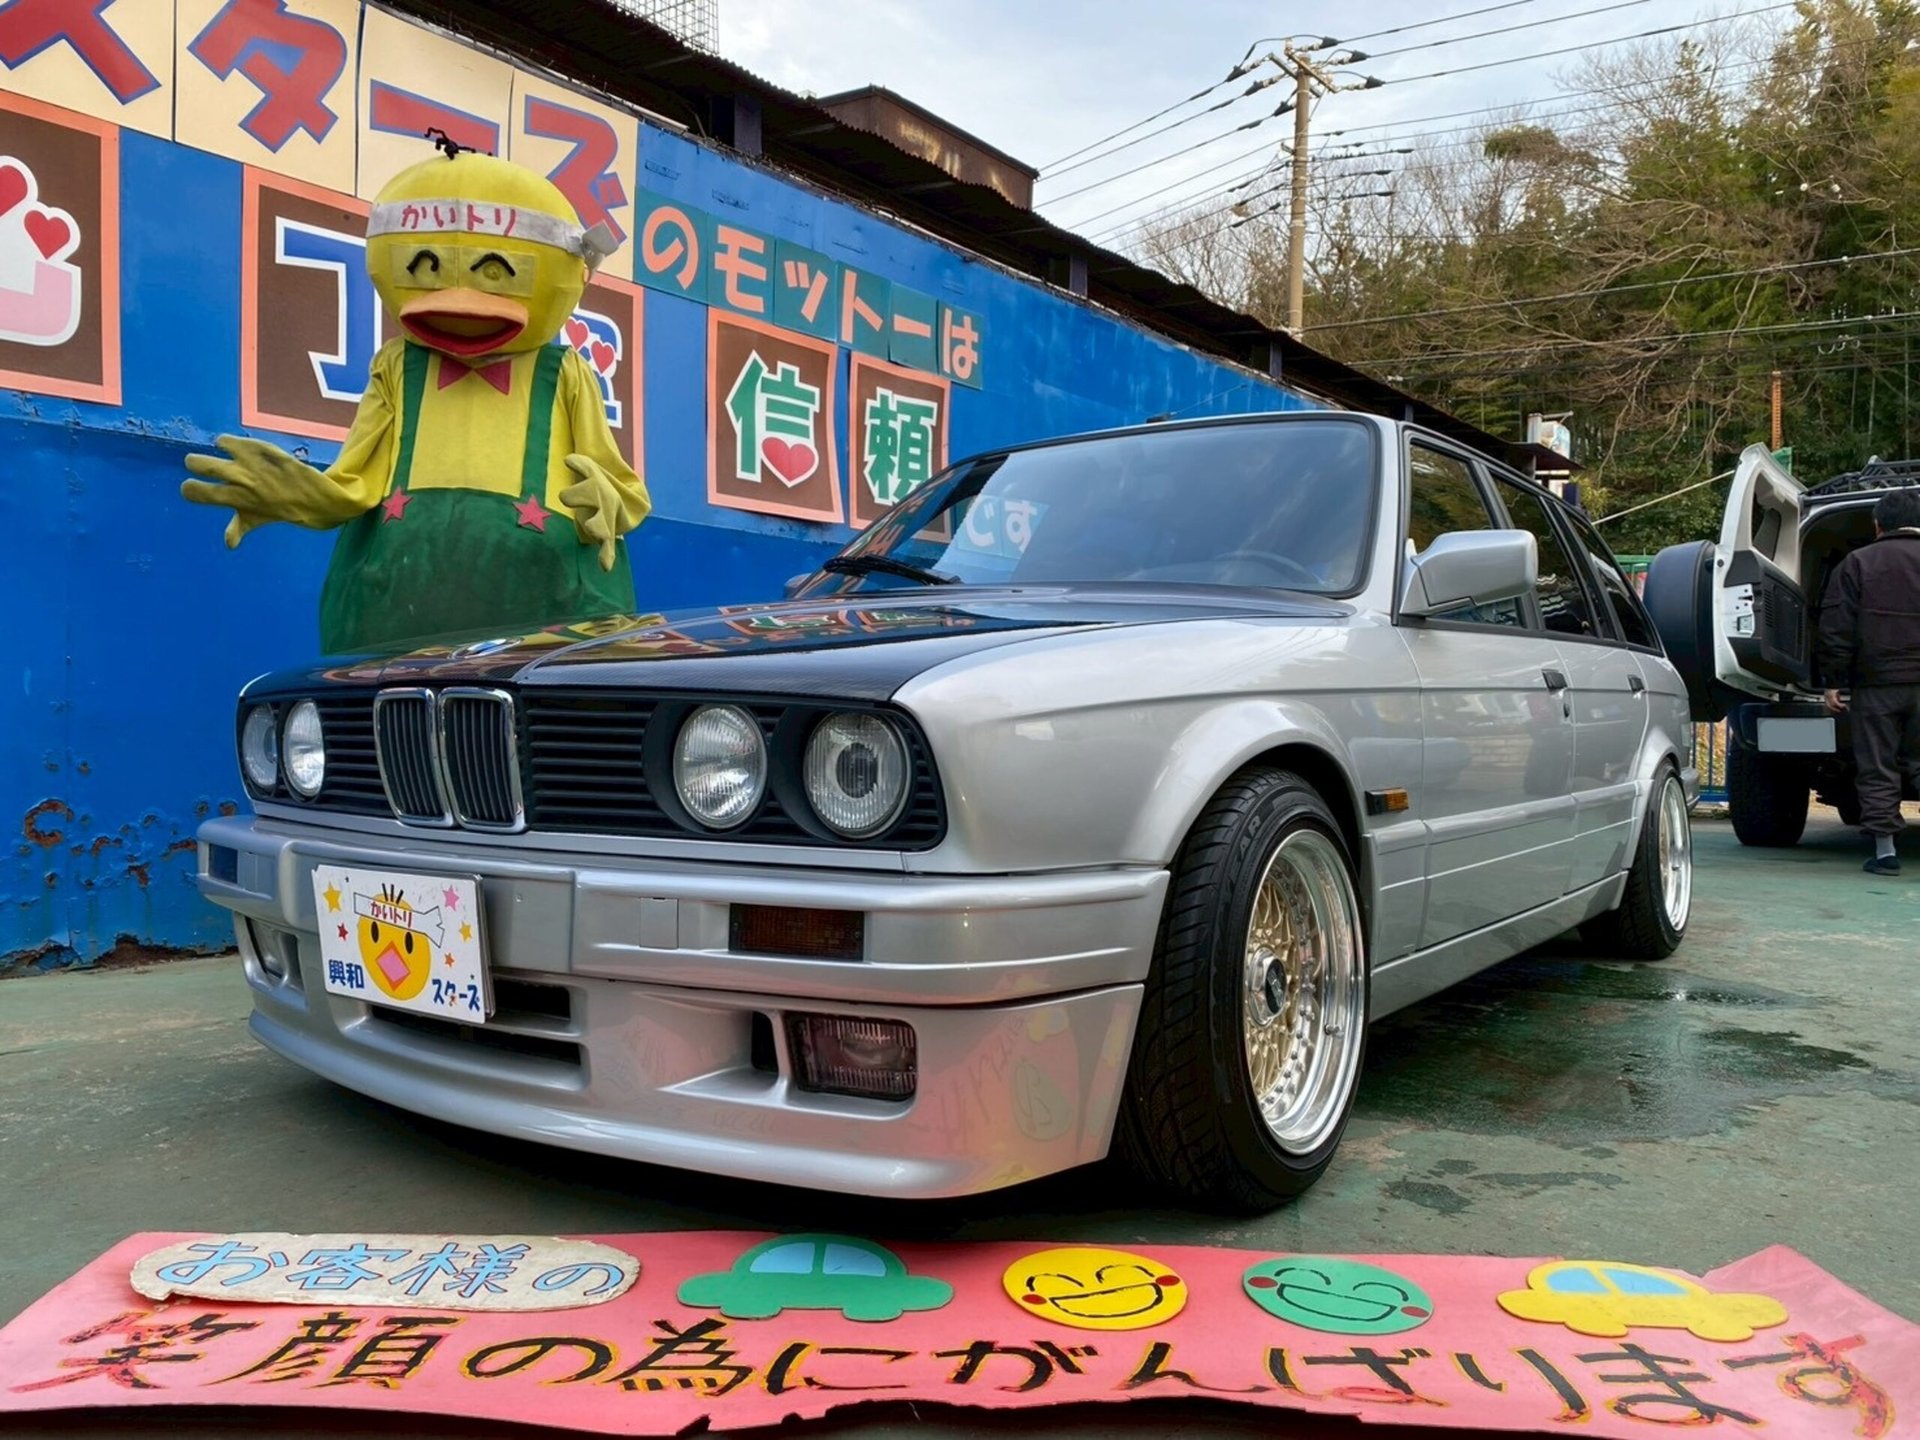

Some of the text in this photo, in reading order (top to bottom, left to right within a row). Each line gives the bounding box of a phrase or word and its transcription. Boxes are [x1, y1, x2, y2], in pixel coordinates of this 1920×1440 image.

[401, 203, 516, 237] かいトリ
[641, 205, 979, 381] のモットーは
[725, 349, 938, 506] 信頼
[370, 901, 413, 929] かいトリ
[328, 959, 364, 989] 興和
[156, 1241, 626, 1298] お客様の
